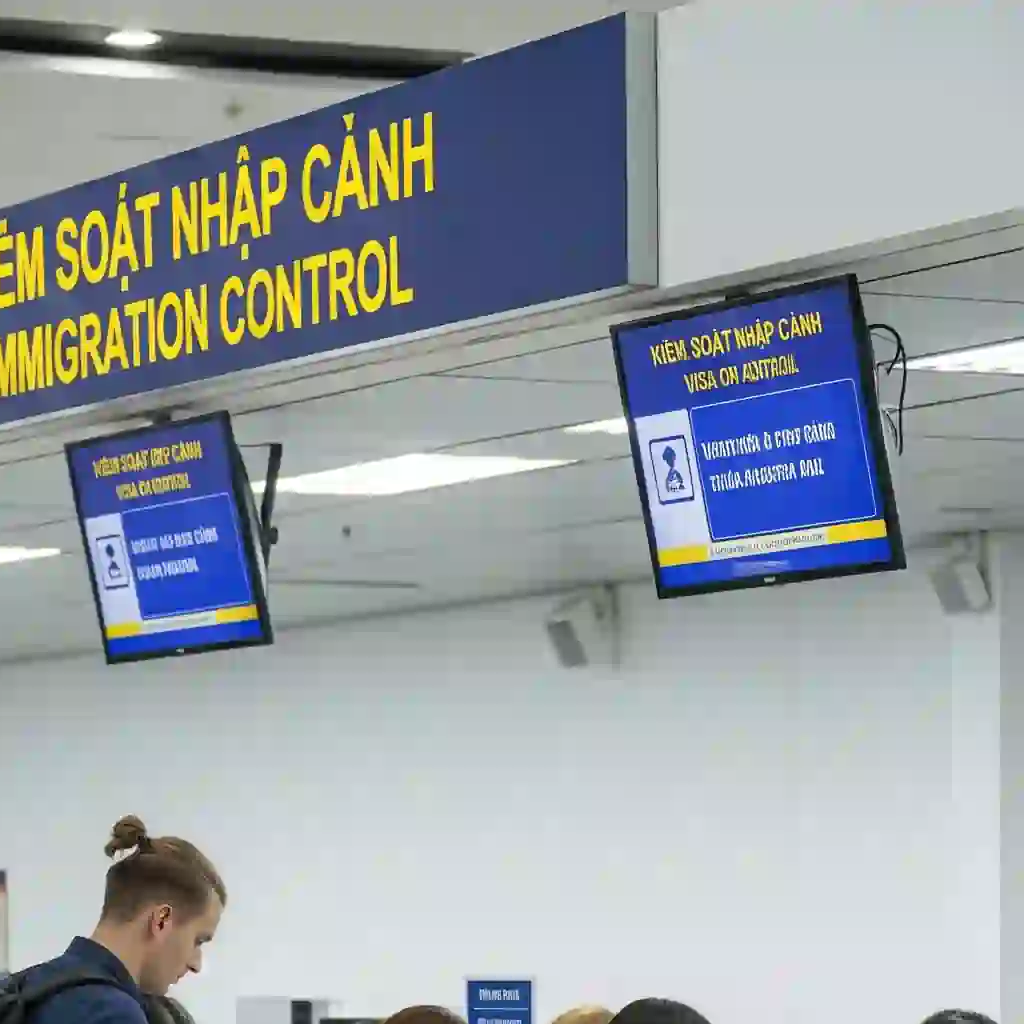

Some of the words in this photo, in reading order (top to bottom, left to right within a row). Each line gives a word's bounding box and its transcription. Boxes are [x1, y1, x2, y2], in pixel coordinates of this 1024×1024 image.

[171, 145, 287, 261] NHẬP
[301, 111, 435, 224] CẢNH
[219, 235, 414, 345] CONTROL
